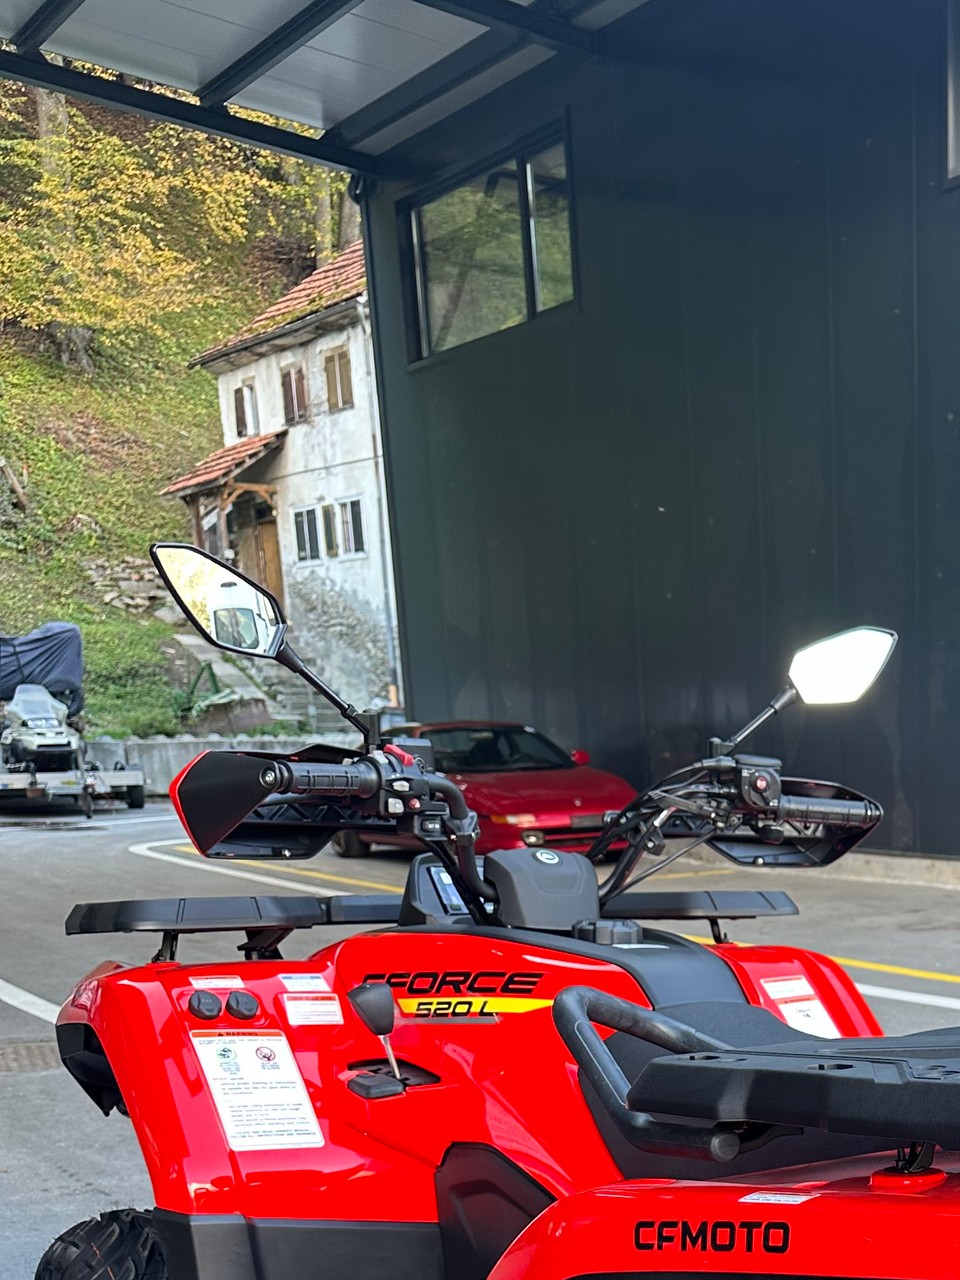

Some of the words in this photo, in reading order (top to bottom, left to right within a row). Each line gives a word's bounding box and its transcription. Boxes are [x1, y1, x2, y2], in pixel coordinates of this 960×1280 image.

[415, 1001, 473, 1018] 520
[478, 1000, 499, 1017] L
[635, 1220, 790, 1254] CFMOTO
